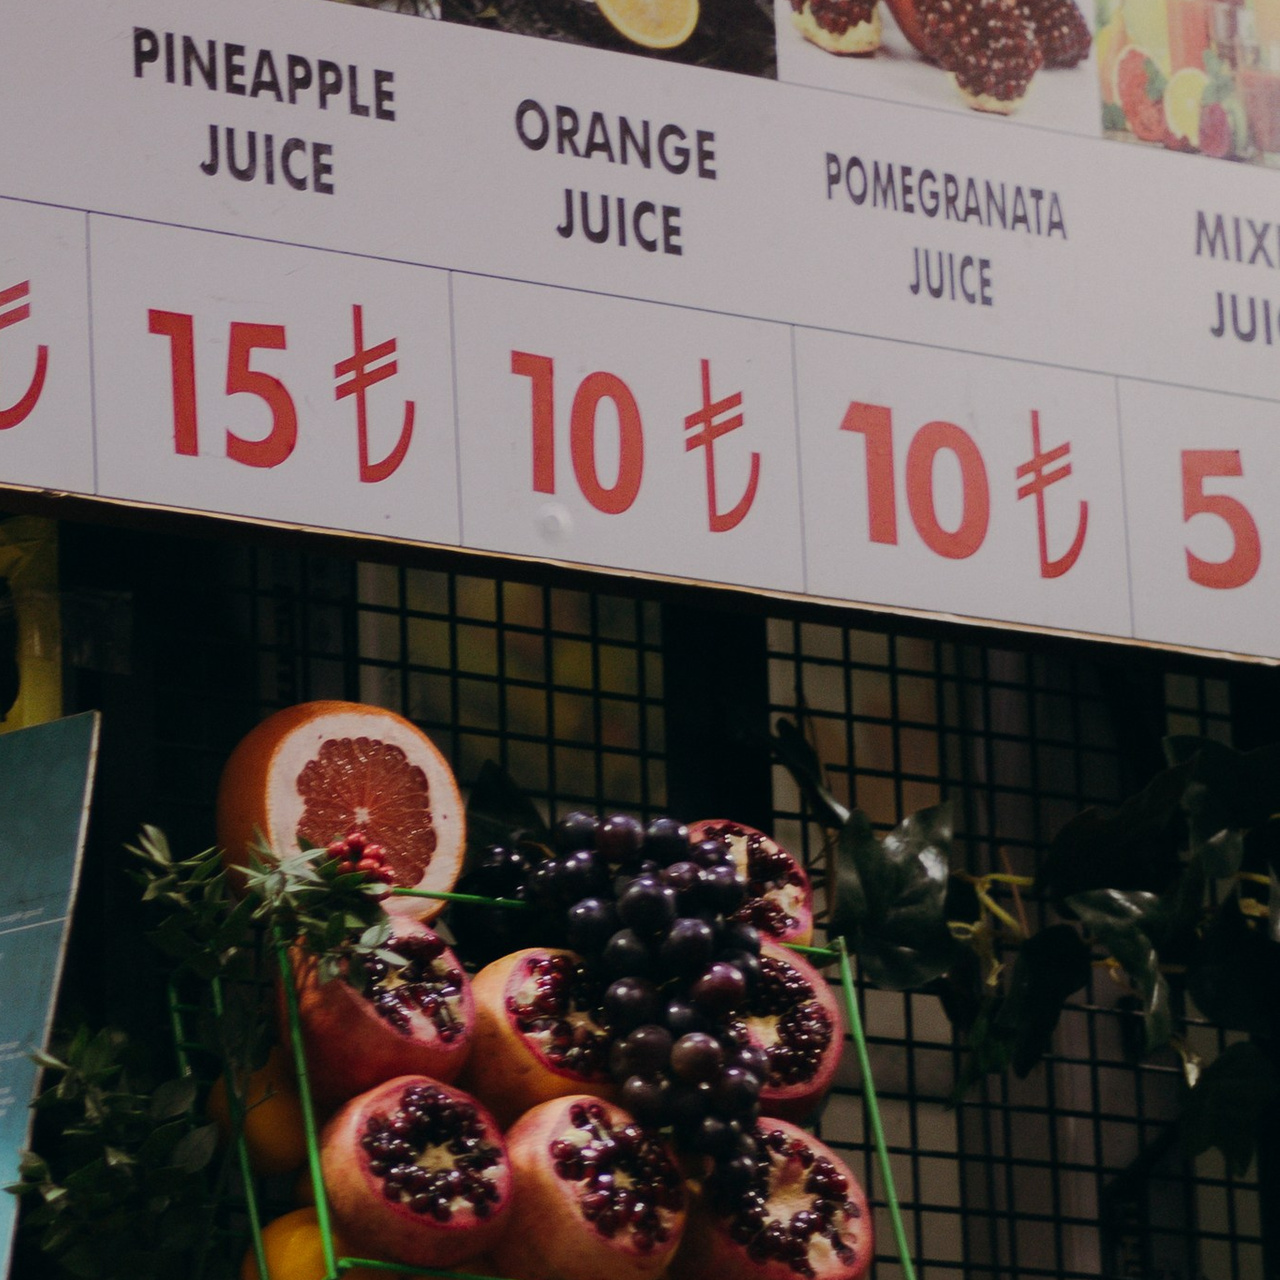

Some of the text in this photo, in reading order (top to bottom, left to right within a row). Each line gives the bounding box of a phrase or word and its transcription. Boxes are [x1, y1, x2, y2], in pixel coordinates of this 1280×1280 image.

[133, 26, 397, 122] PINEAPPLE
[199, 124, 334, 195] JUICE
[515, 98, 718, 181] ORANGE
[556, 188, 683, 257] JUICE
[824, 152, 1068, 241] POMEGRANATA
[909, 246, 994, 308] JUICE
[1195, 210, 1280, 270] MIX
[1210, 291, 1280, 346] JUI
[147, 308, 299, 469] 15
[510, 349, 644, 516] 10
[839, 400, 990, 561] 10
[1180, 449, 1262, 590] 5
